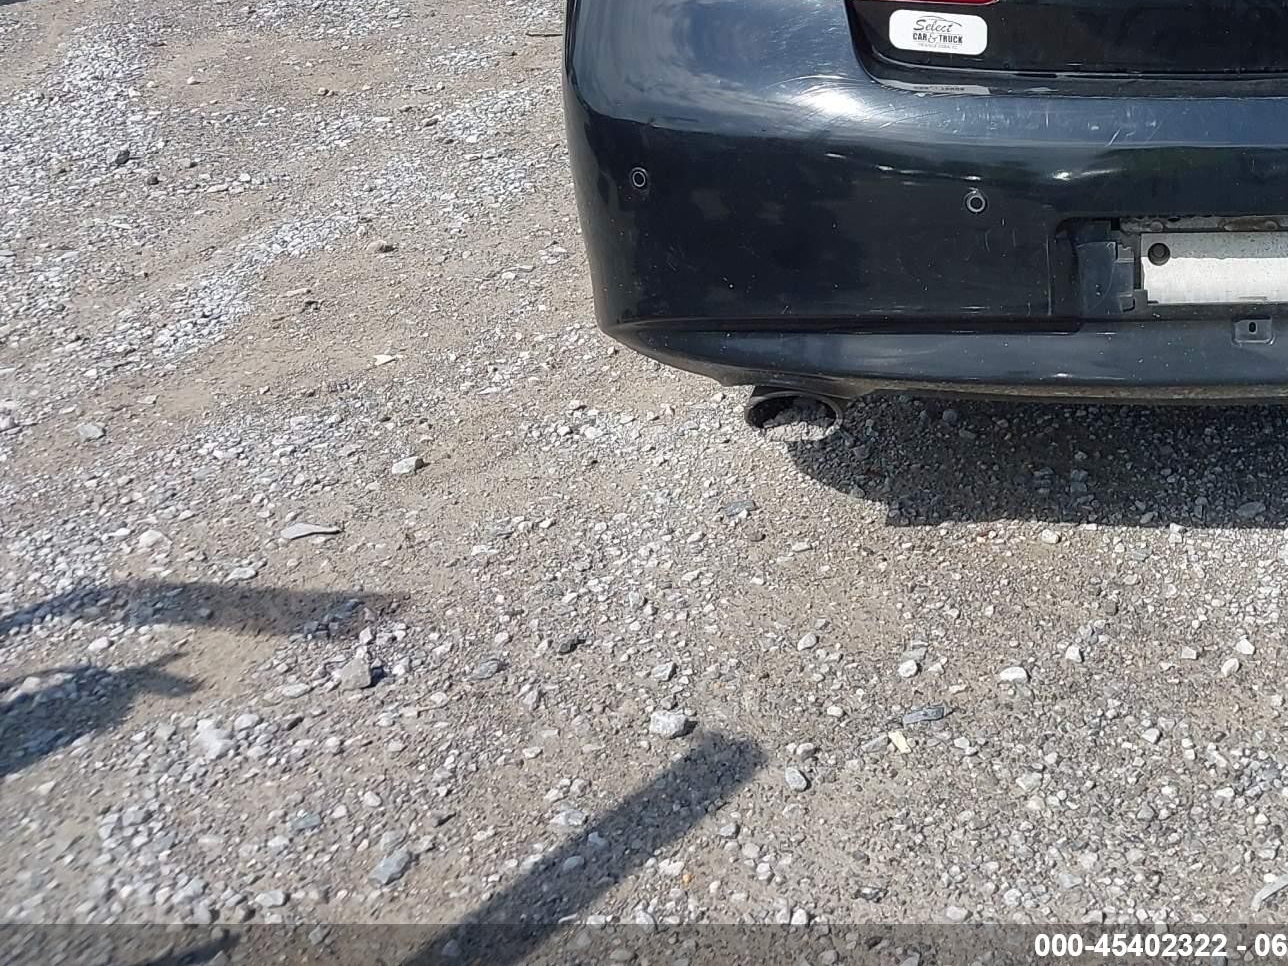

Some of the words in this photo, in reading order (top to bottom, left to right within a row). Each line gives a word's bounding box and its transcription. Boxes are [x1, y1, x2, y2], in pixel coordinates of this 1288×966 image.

[912, 18, 954, 33] Select
[912, 32, 928, 41] CAR
[939, 34, 964, 44] TRUCK
